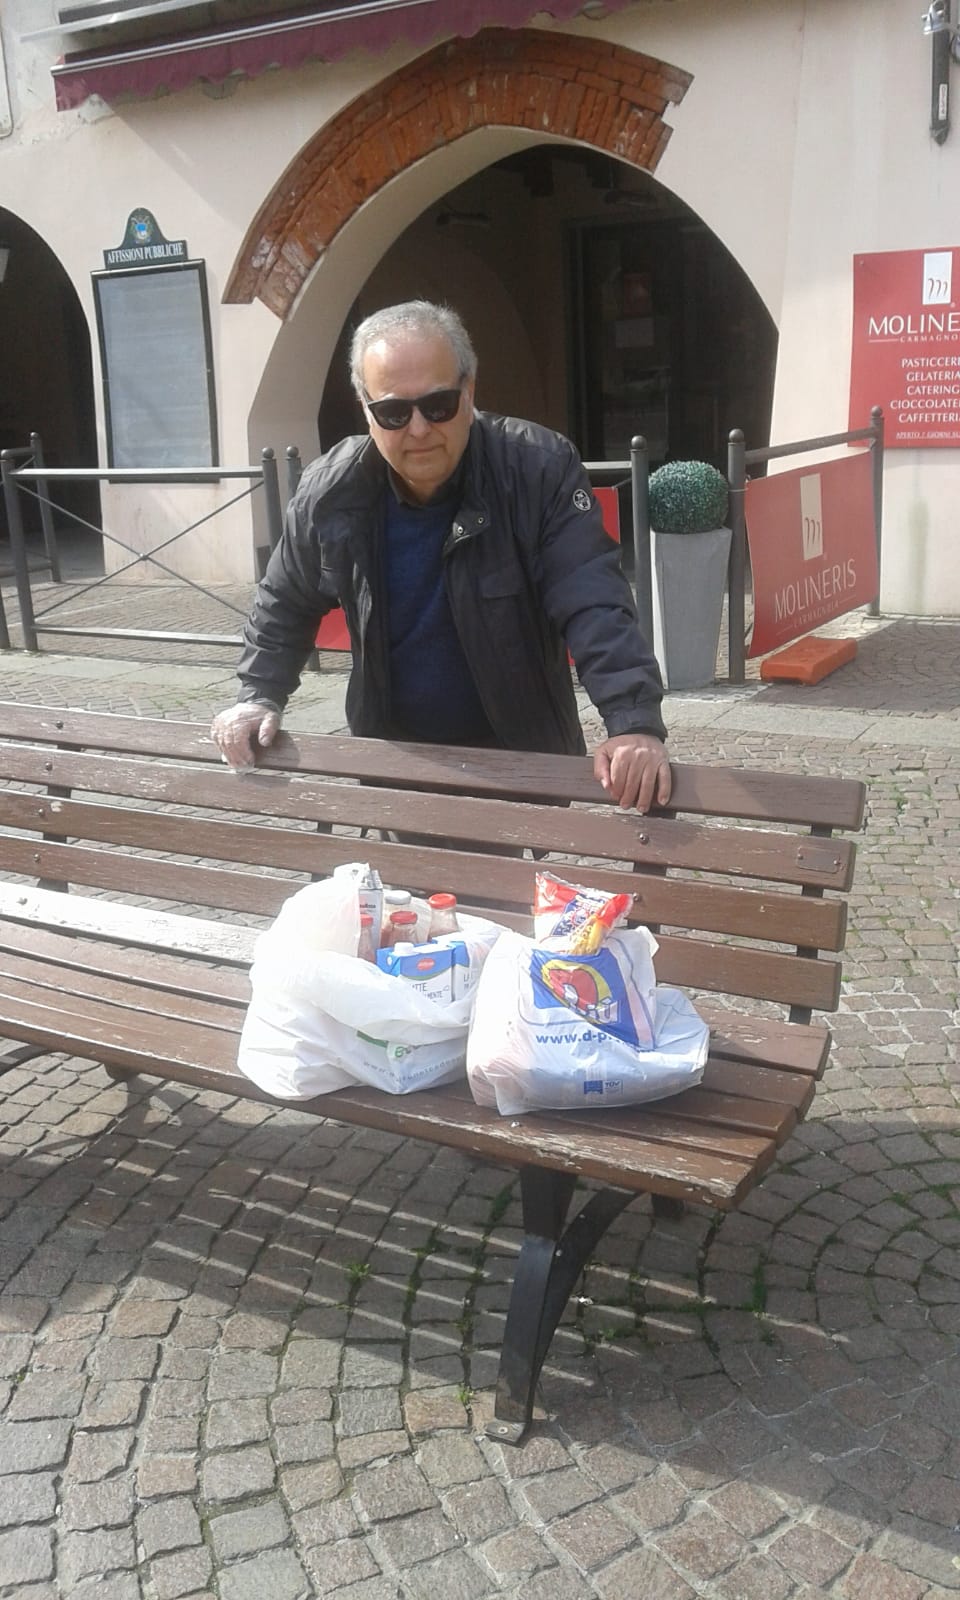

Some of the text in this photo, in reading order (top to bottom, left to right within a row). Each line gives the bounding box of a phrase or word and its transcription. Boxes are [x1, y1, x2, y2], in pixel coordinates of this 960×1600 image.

[106, 242, 184, 264] AFFISSIONI PUBBLICHE
[868, 311, 960, 336] MOLINE
[906, 384, 960, 395] CATERING
[890, 398, 960, 410] CIOCCOLATE
[898, 412, 960, 423] CAFFETTERI
[775, 558, 857, 623] MOLINERIS
